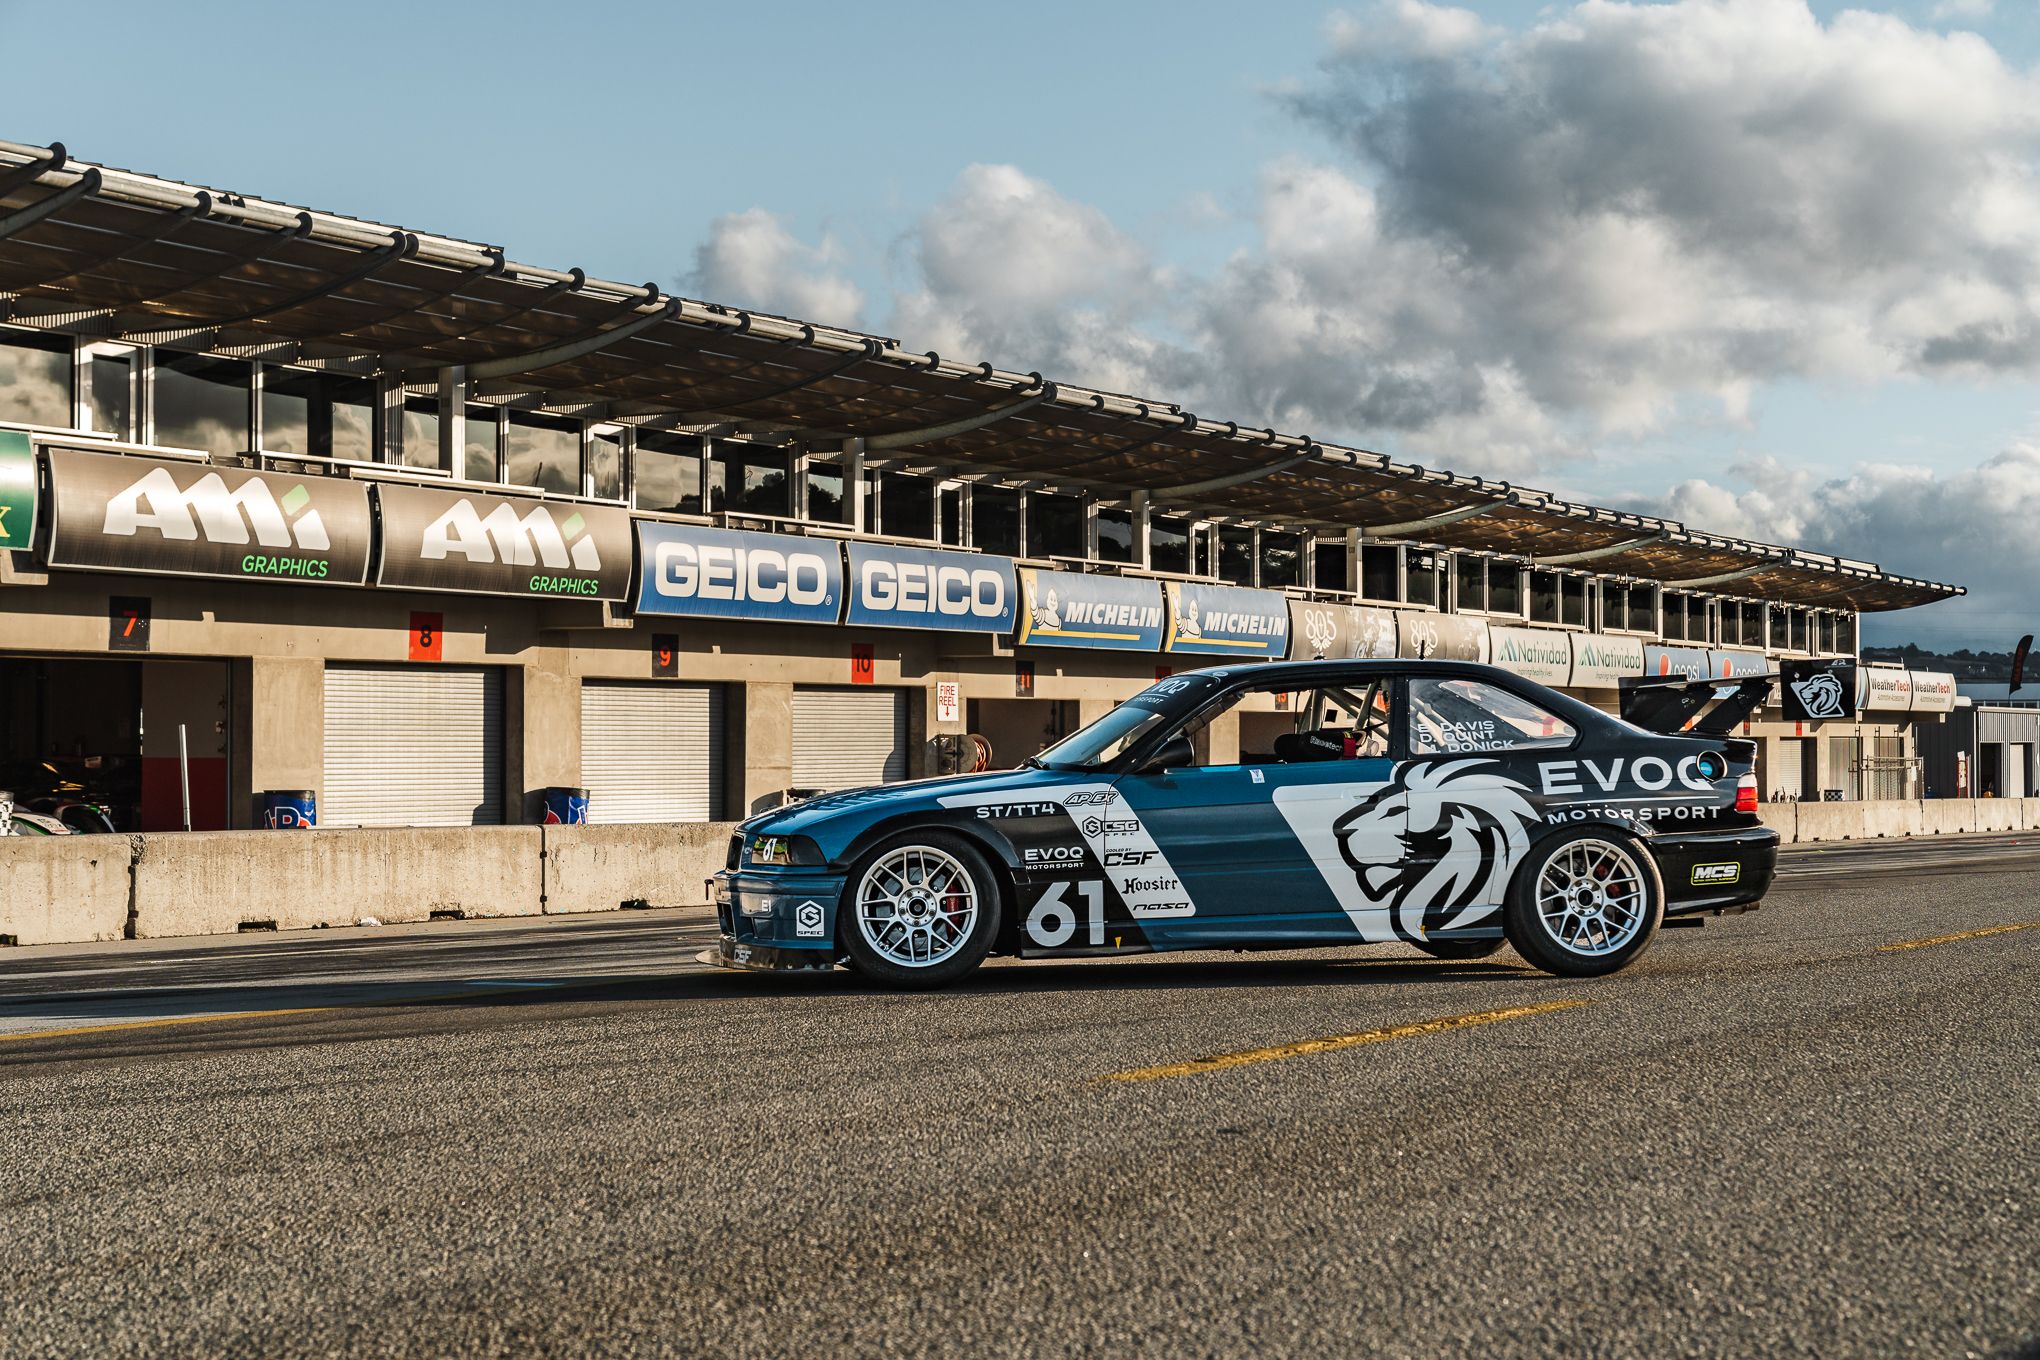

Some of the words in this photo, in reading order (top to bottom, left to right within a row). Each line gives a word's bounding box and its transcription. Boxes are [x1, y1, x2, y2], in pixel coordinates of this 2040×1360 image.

[241, 555, 329, 577] GRAPHICS
[655, 541, 828, 606] GEICO
[529, 575, 599, 594] GRAPHICS
[861, 559, 1005, 618] GEICO
[122, 610, 138, 637] 7
[1065, 602, 1161, 628] MICHELIN
[1204, 611, 1286, 636] MICHELIN
[1305, 609, 1337, 641] 805
[1410, 620, 1438, 648] 805
[420, 624, 432, 647] 8
[659, 645, 671, 667] 9
[1517, 639, 1567, 665] Natividad
[1597, 644, 1641, 669] Natividad
[855, 654, 870, 673] 10
[1021, 671, 1030, 689] 11
[1871, 678, 1910, 692] WeatherTech
[1914, 681, 1951, 694] WeatherTech
[940, 685, 955, 696] FIRE
[939, 696, 957, 706] REEL
[1440, 720, 1494, 731] DAVIS
[1420, 734, 1437, 742] D.
[1443, 730, 1494, 742] QUINT
[1448, 740, 1514, 752] DONICK
[1538, 755, 1714, 795] EVOQ
[976, 803, 1055, 818] ST/TT4
[1547, 805, 1721, 824] MOTORSPORT
[1104, 820, 1138, 831] CSG
[763, 838, 777, 862] 61
[1025, 847, 1084, 861] EVOQ
[1104, 850, 1159, 867] CSF
[1026, 862, 1084, 870] MOTORSPORT
[1693, 865, 1738, 879] MCS
[1121, 876, 1178, 894] Hoosier
[1026, 880, 1104, 947] 61
[1133, 902, 1189, 911] nasa
